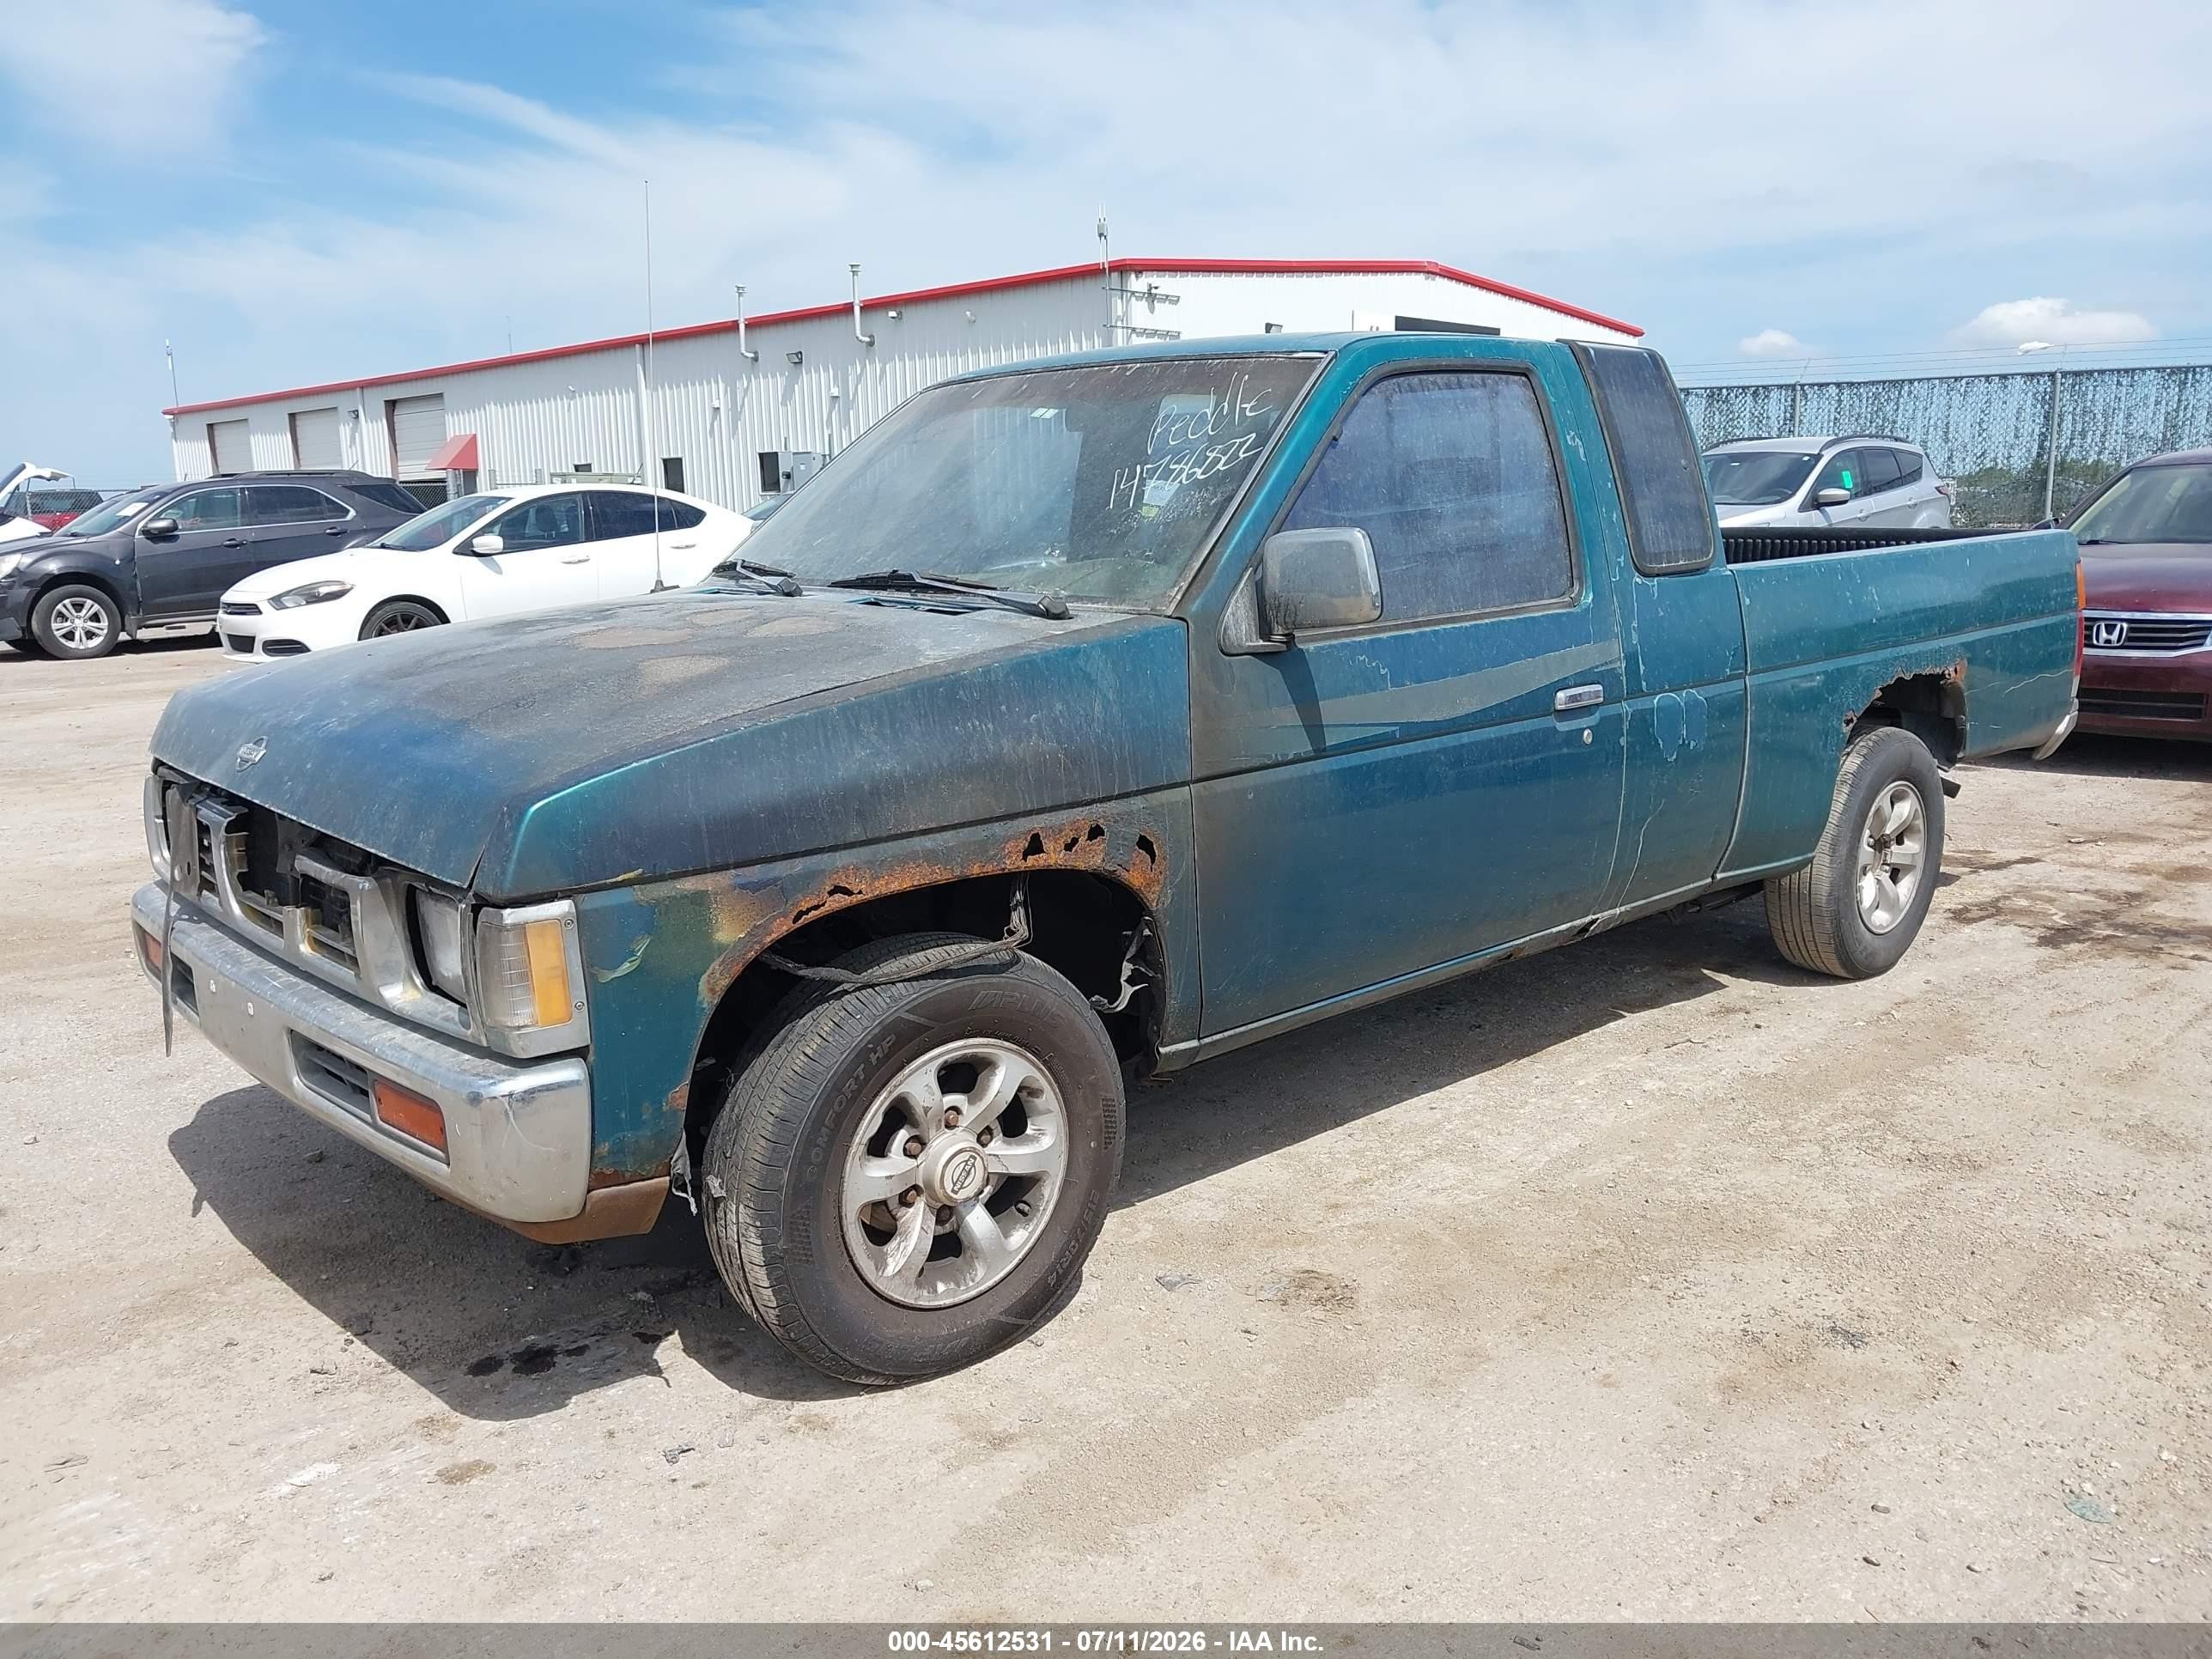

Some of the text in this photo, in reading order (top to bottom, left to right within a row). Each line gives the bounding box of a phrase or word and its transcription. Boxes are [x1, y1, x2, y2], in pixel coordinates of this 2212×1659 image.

[1147, 371, 1273, 455] Peddle
[869, 1033, 896, 1066] HP
[953, 1157, 975, 1192] NISSAN
